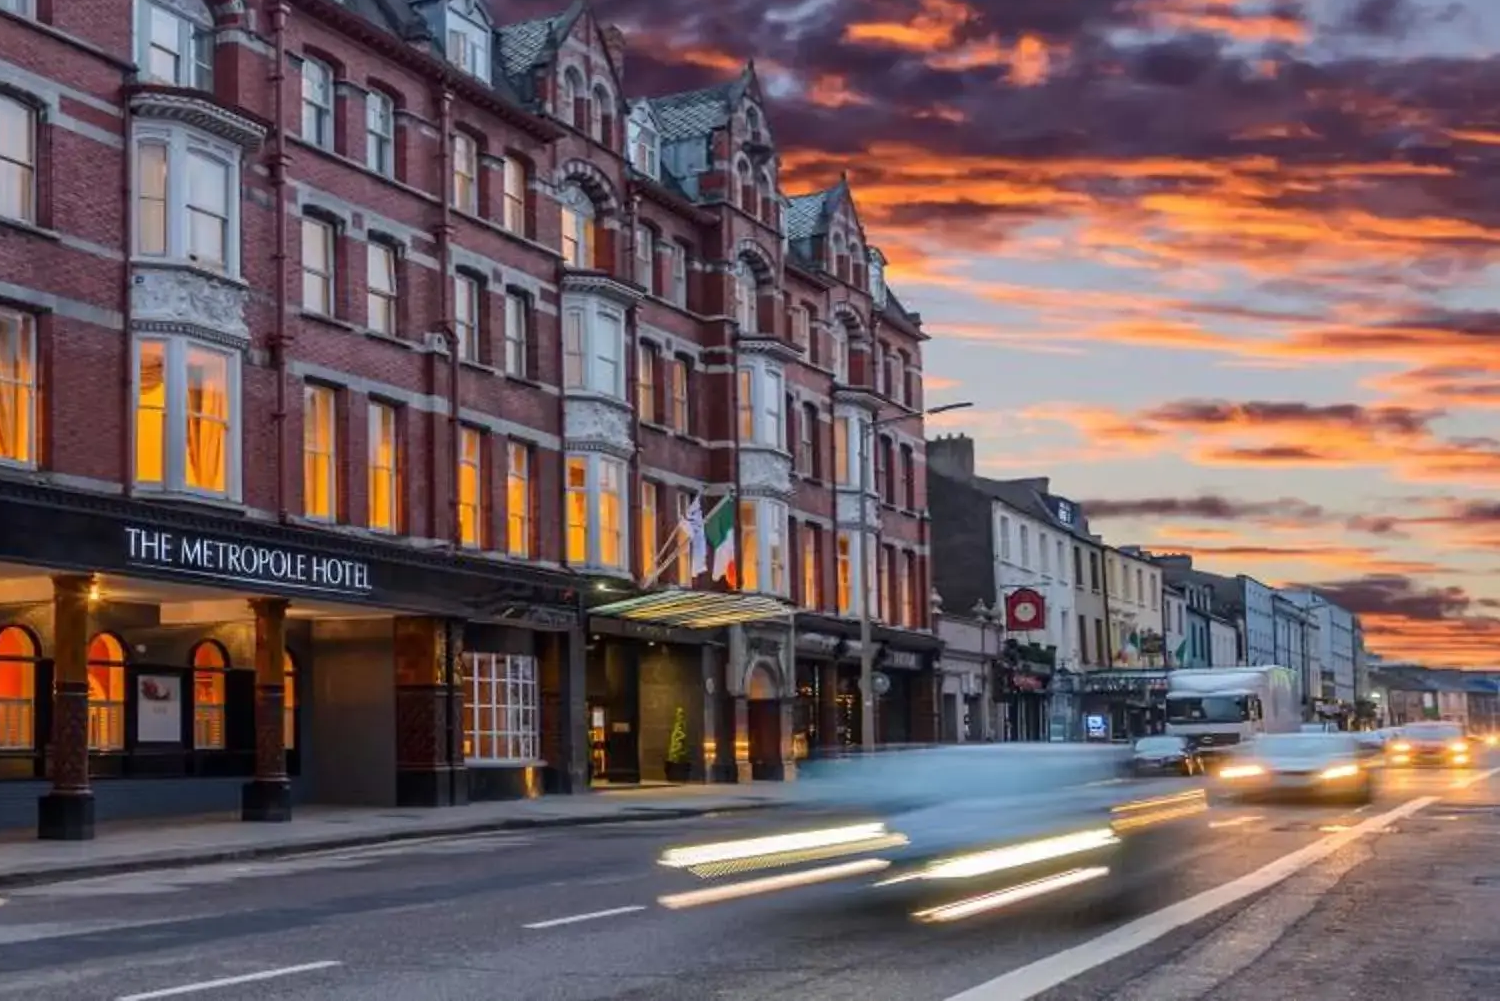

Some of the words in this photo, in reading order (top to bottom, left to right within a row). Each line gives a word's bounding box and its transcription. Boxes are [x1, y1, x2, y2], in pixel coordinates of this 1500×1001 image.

[125, 528, 173, 562] THE
[181, 536, 306, 581] METROPOLE
[312, 556, 373, 590] HOTEL
